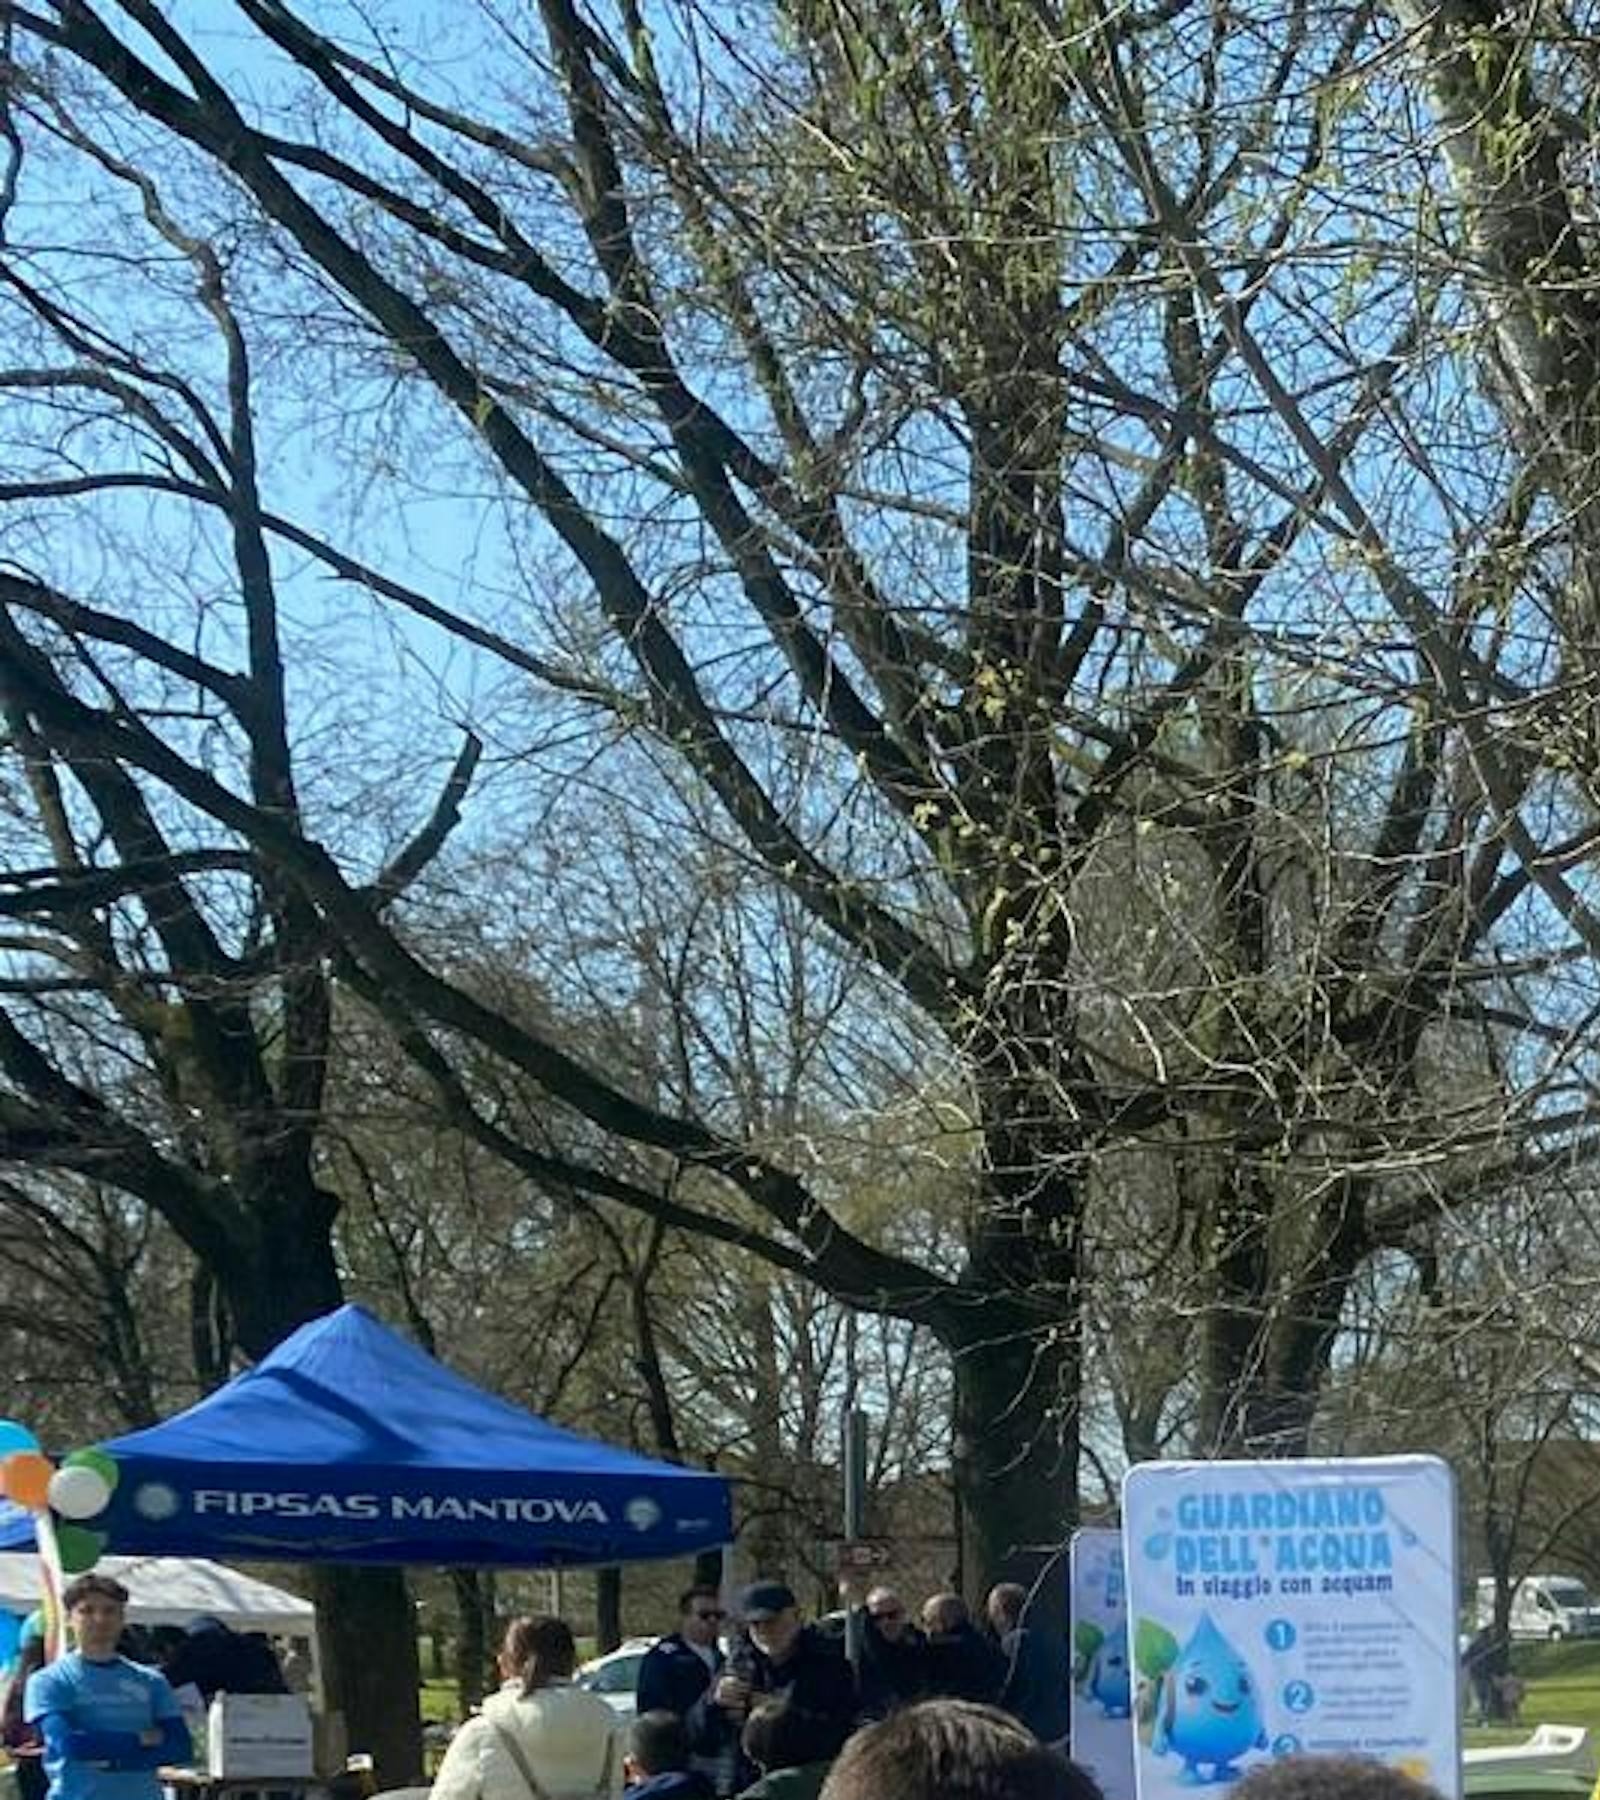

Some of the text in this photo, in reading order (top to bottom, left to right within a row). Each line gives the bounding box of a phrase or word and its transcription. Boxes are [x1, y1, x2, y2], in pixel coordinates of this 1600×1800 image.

[192, 1489, 608, 1524] FIPSAS MANTOVA
[1177, 1488, 1386, 1531] GUARDIANO
[1176, 1577, 1195, 1596] In
[1203, 1576, 1272, 1600] viaggio
[1281, 1578, 1311, 1595] con
